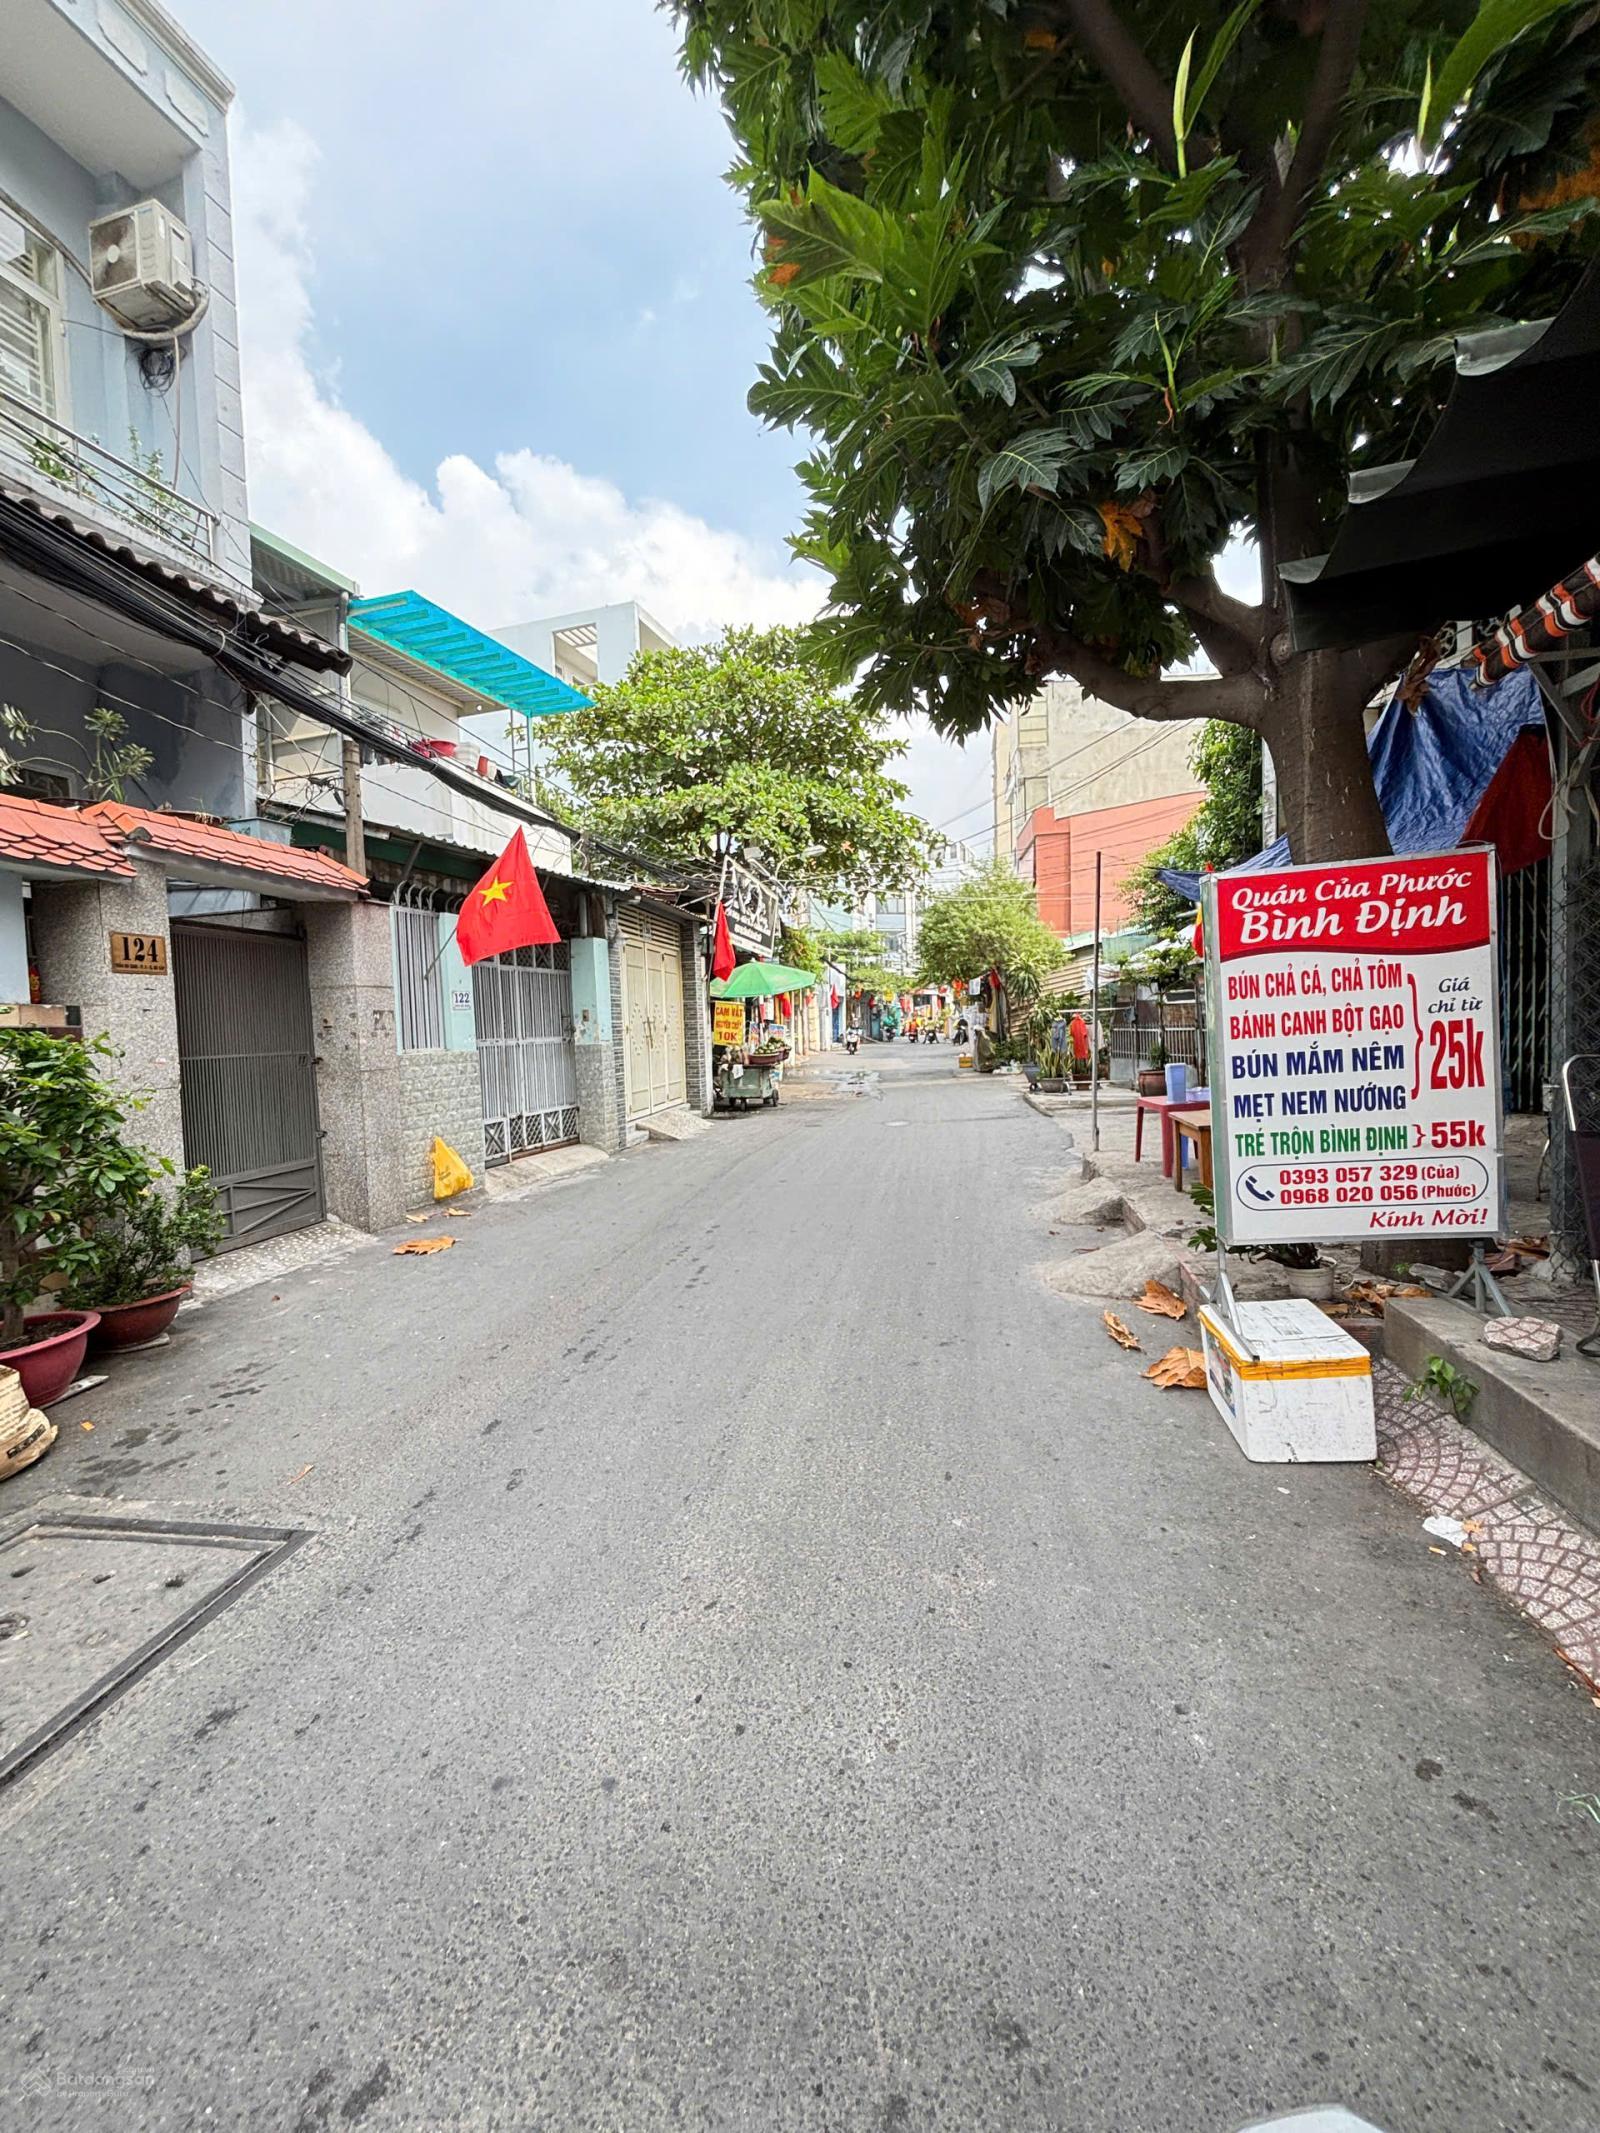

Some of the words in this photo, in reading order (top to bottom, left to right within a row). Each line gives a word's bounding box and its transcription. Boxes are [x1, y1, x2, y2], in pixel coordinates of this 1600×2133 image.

[1232, 884, 1307, 912] Quán
[1314, 877, 1372, 901] Của
[1379, 868, 1473, 896] Phước
[1240, 907, 1343, 944] Bình
[1355, 896, 1467, 937] Định
[122, 936, 159, 962] 124
[454, 992, 470, 1004] 122
[1228, 970, 1260, 1000] BÚN
[1265, 963, 1297, 998] CHẢ
[1301, 964, 1327, 997] CÁ,
[1331, 958, 1364, 993] CHẢ
[1367, 959, 1402, 990] TÔM
[1438, 976, 1470, 993] Giá
[1230, 1010, 1276, 1040] BÁNH
[1281, 1009, 1327, 1036] CANH
[1332, 1002, 1364, 1038] BỘT
[1369, 1004, 1404, 1035] GẠO
[1428, 999, 1456, 1014] chỉ
[1461, 996, 1483, 1011] từ
[1232, 1049, 1278, 1079] BÚN
[1286, 1041, 1344, 1076] MẮM
[1352, 1041, 1405, 1072] NÊM
[1429, 1018, 1485, 1090] 25k
[1234, 1093, 1275, 1122] MẸT
[1282, 1090, 1327, 1115] NEM
[1335, 1082, 1406, 1113] NƯỚNG
[1235, 1127, 1265, 1157] TRÉ
[1270, 1125, 1314, 1160] TRỘN
[1319, 1124, 1361, 1153] BÌNH
[1366, 1125, 1408, 1156] ĐỊNH
[1431, 1120, 1486, 1149] 55k
[1279, 1168, 1329, 1185] 0393
[1335, 1166, 1373, 1182] 057
[1379, 1164, 1418, 1181] 329
[1421, 1164, 1460, 1181] (Của)
[1280, 1187, 1329, 1205] 0968
[1336, 1186, 1373, 1203] 020
[1380, 1184, 1418, 1201] 056
[1421, 1182, 1476, 1199] (Phước)
[1369, 1211, 1425, 1228] Kính
[1432, 1208, 1489, 1226] Mời!
